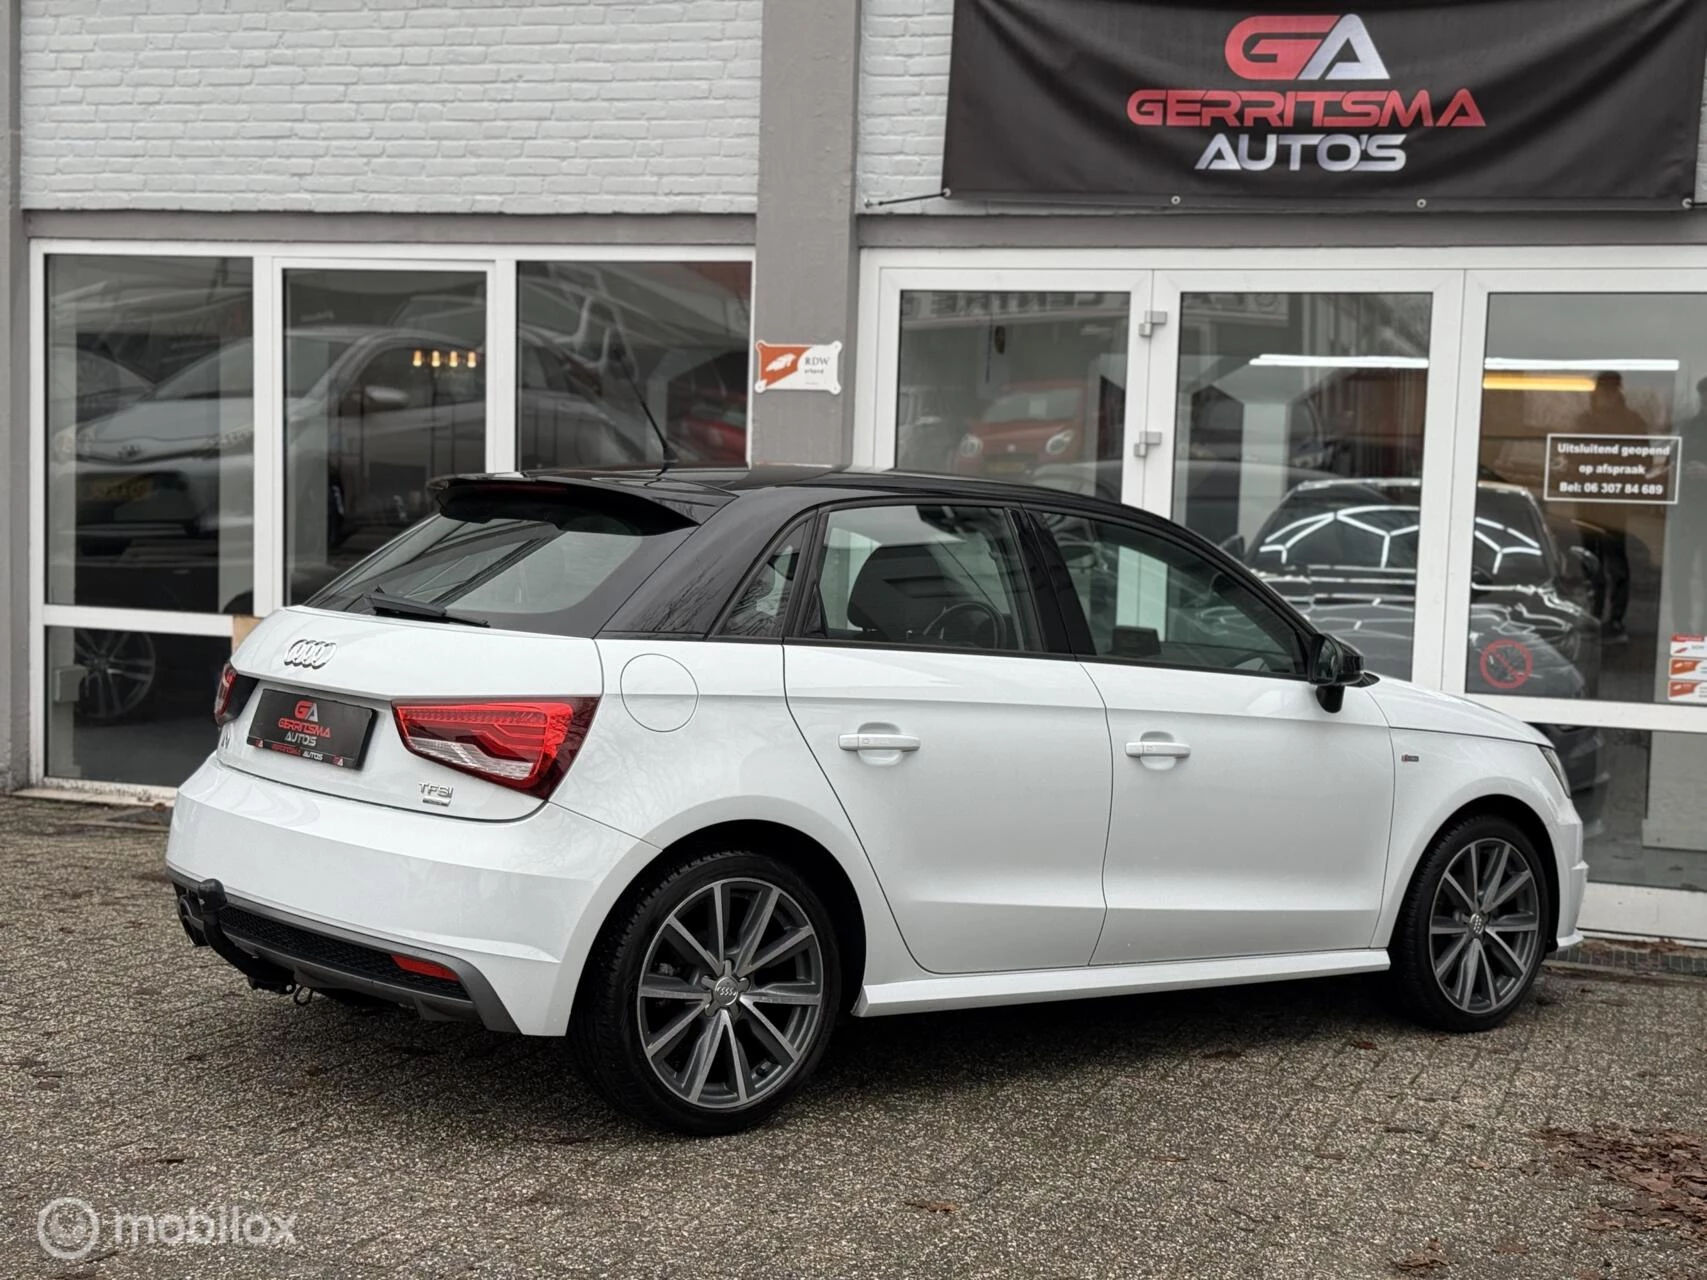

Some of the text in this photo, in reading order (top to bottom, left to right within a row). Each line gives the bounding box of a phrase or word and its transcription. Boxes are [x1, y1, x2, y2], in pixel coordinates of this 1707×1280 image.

[1224, 13, 1390, 80] GA
[1127, 88, 1486, 128] GERRITSMA
[1194, 132, 1407, 172] AUTO'S
[1557, 443, 1670, 457] Uitsluitend geopend
[1578, 463, 1646, 475] op afspraak
[1559, 481, 1664, 495] Bel: 06 307 84 689
[294, 700, 319, 722] GA
[277, 717, 331, 738] GERRITSMA
[419, 782, 454, 798] TFSI
